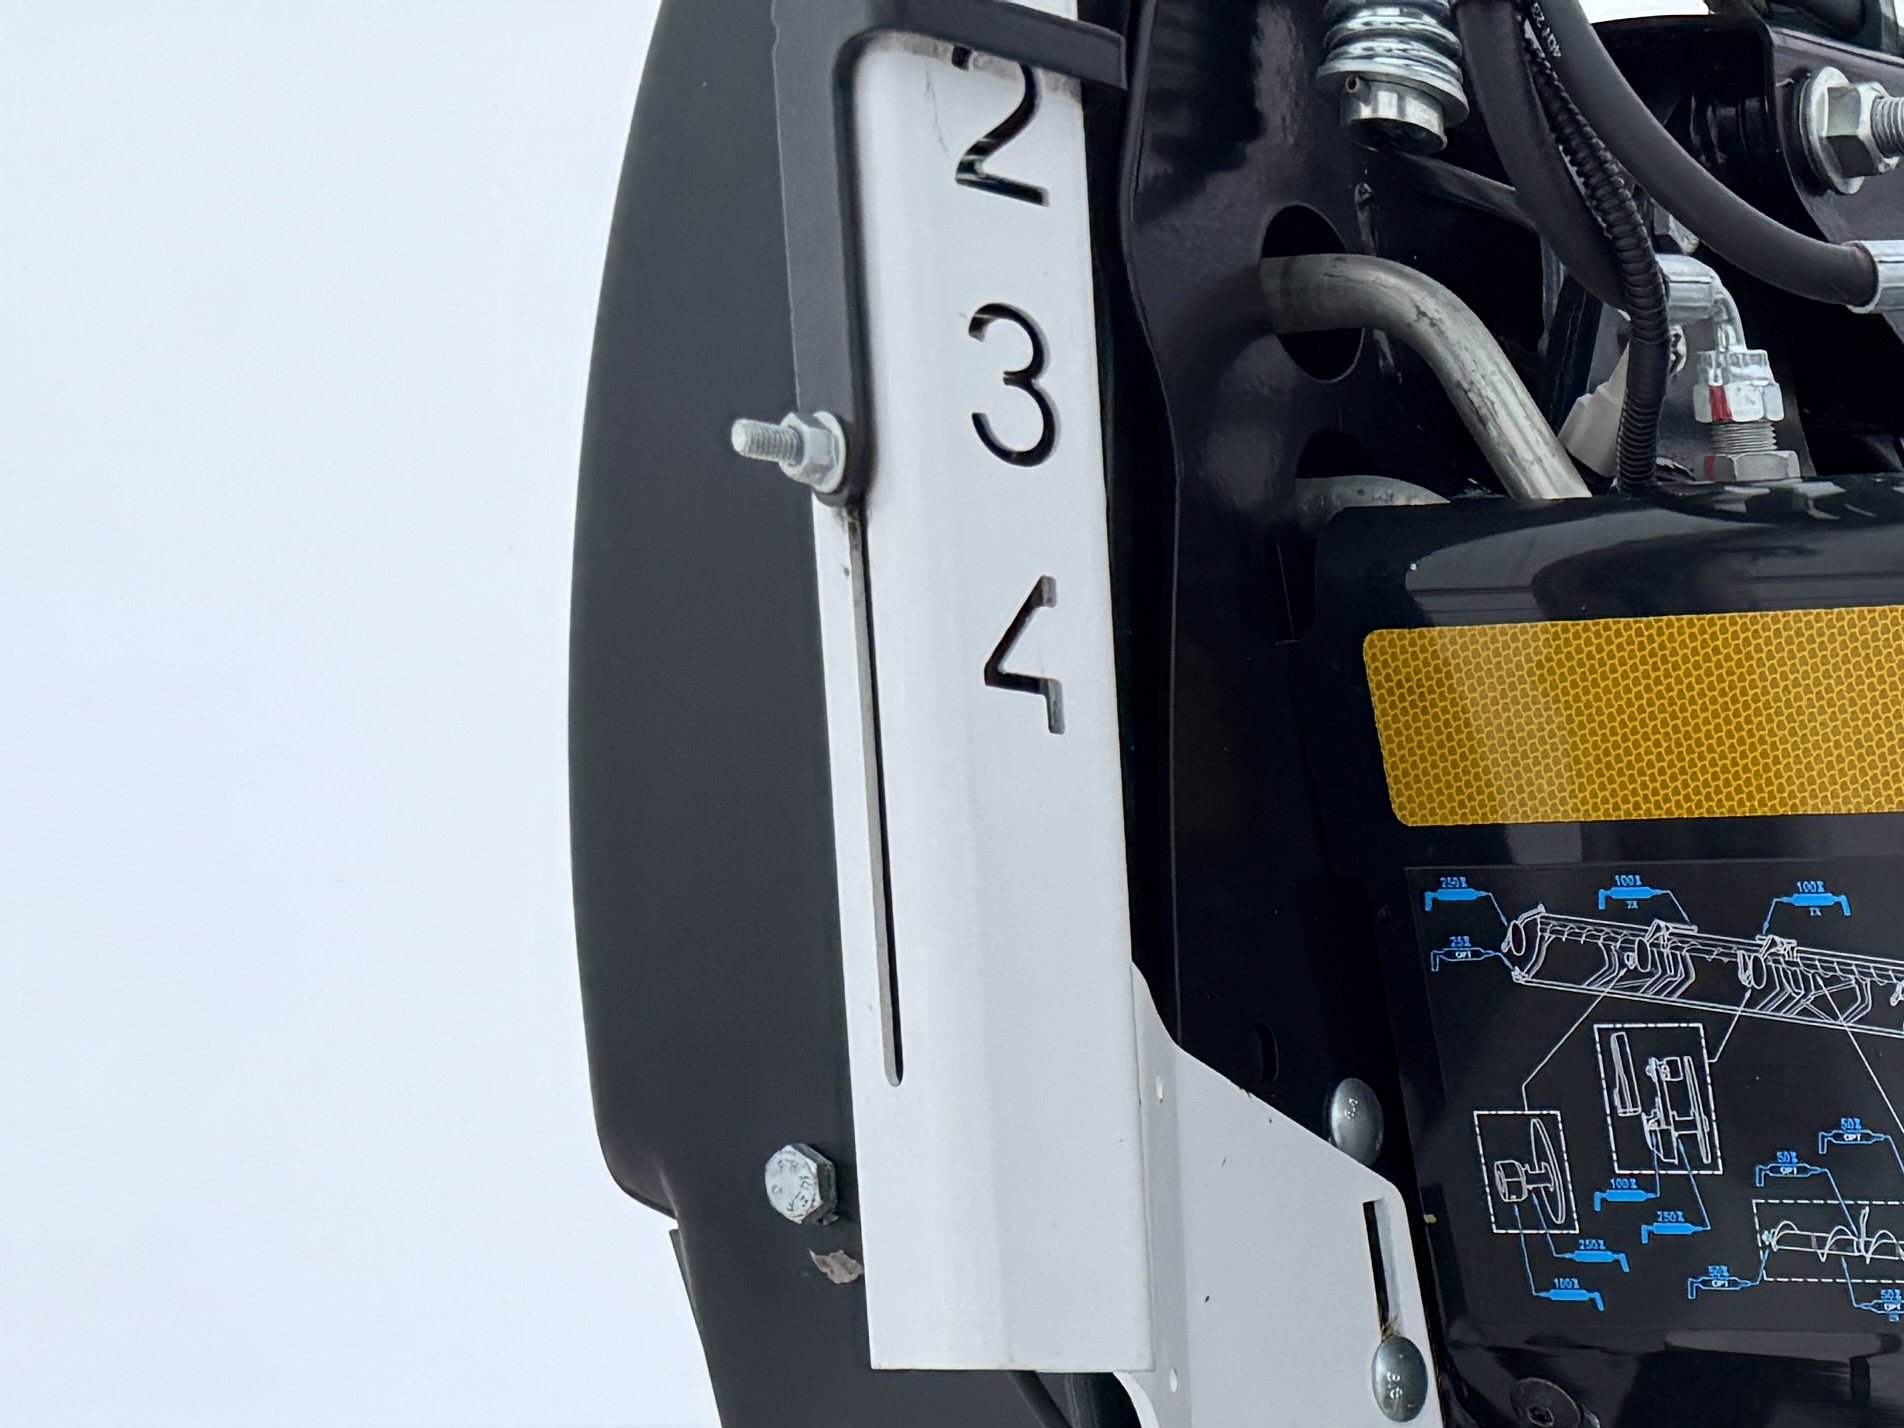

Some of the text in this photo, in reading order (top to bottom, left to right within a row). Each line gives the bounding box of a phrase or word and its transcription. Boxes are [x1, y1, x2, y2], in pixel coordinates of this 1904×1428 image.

[952, 45, 1050, 206] 2
[968, 303, 1060, 467] 3
[984, 575, 1066, 735] 4
